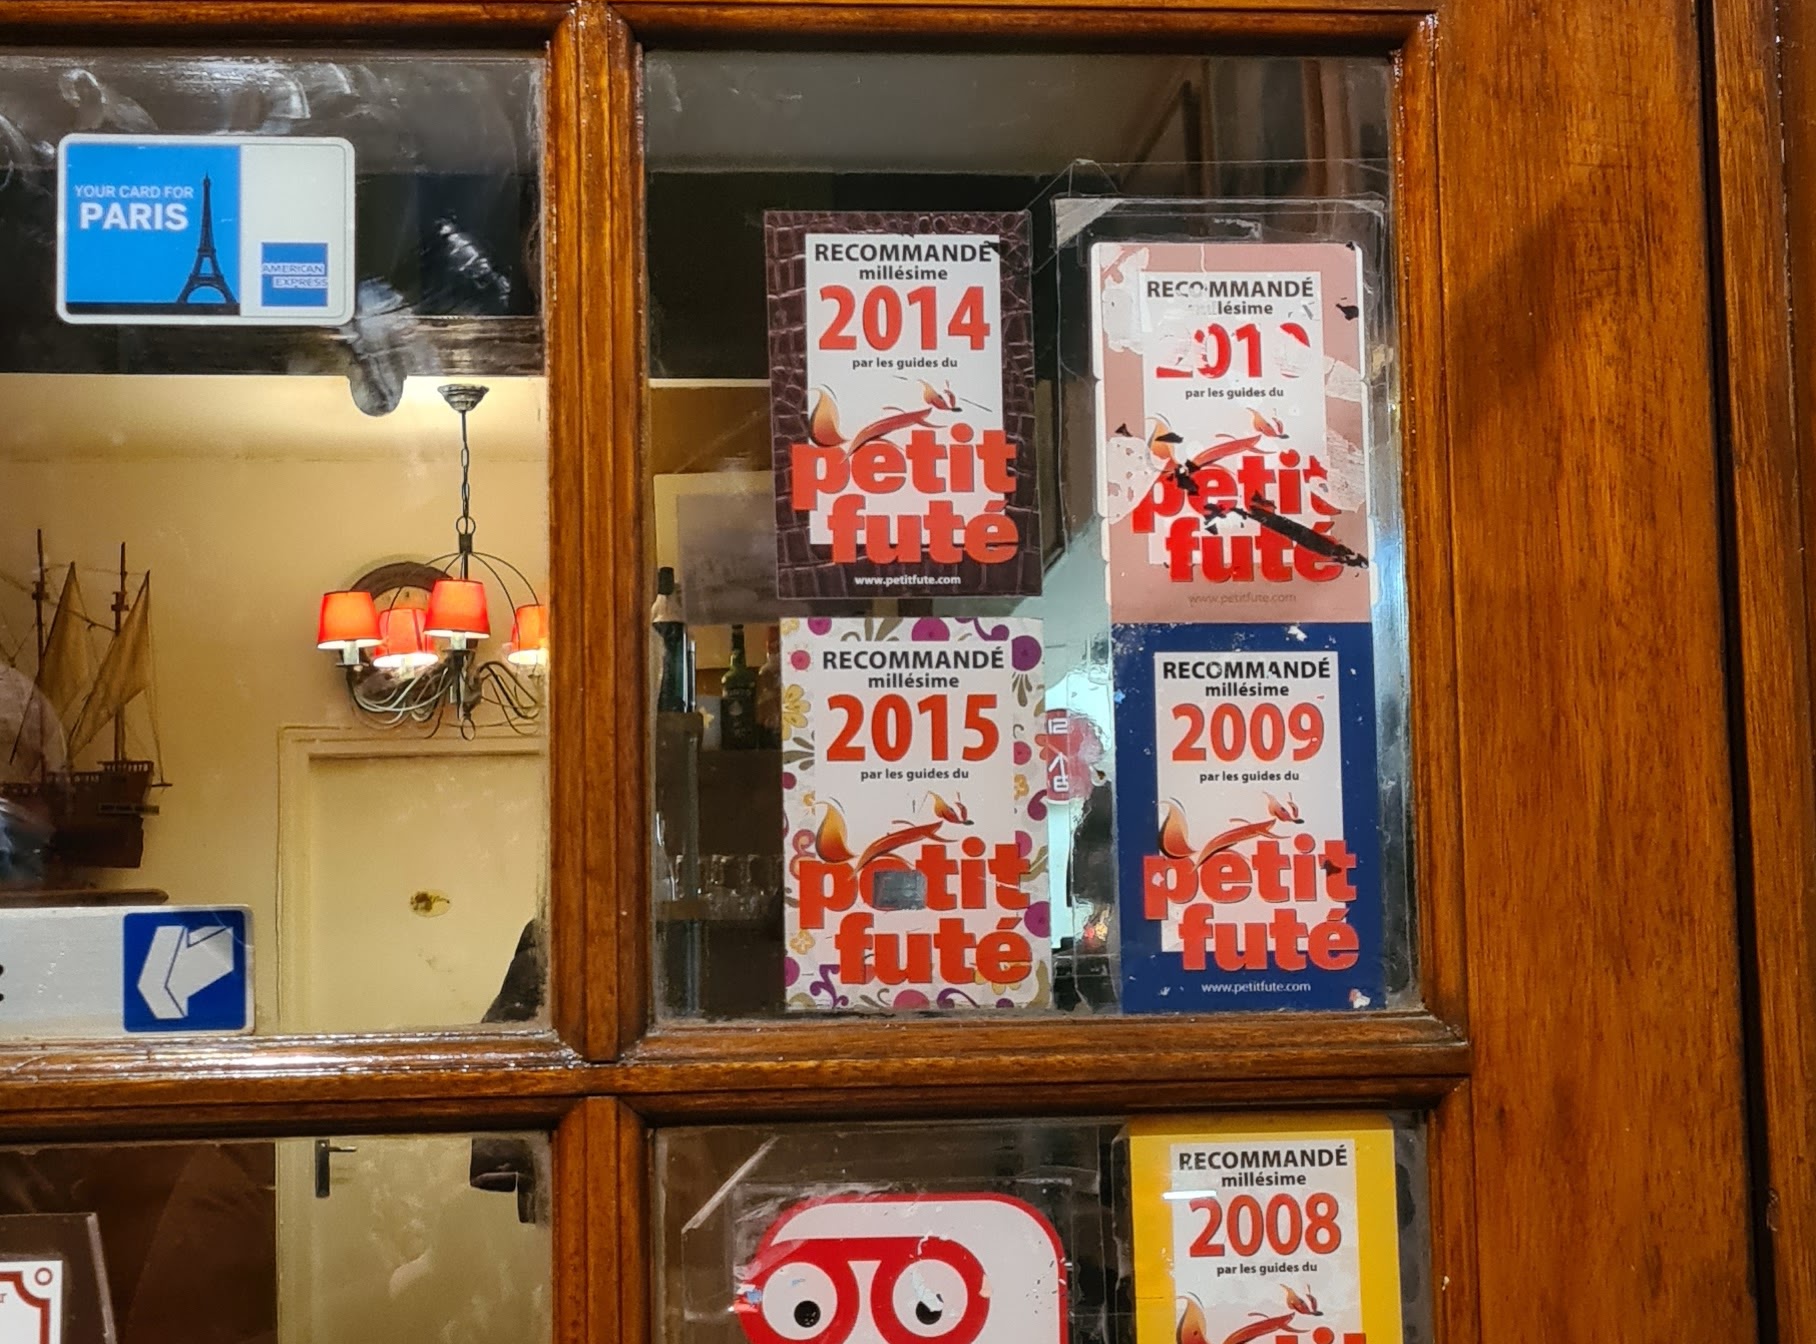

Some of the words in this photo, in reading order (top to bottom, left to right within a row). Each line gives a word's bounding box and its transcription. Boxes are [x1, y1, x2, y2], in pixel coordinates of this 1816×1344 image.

[75, 184, 115, 198] YOUR
[119, 185, 161, 199] CARD
[164, 186, 194, 199] FOR
[79, 202, 189, 230] PARIS
[262, 264, 323, 274] AMERICAN
[859, 265, 948, 280] millésime
[275, 277, 328, 287] EXPRESS
[819, 284, 990, 351] 2014
[852, 358, 873, 370] par
[876, 357, 894, 368] les
[896, 357, 939, 370] guides
[941, 357, 958, 368] du
[1185, 388, 1205, 400] par
[1207, 387, 1224, 398] les
[1226, 387, 1266, 400] guides
[1268, 387, 1284, 398] du
[791, 423, 1017, 511] petit
[828, 494, 1019, 564] futé
[1165, 517, 1344, 583] futé
[854, 574, 961, 586] www.petitfute.com
[1187, 592, 1297, 605] www.petitfute.com
[823, 646, 1004, 670] RECOMMANDÉ
[1163, 657, 1331, 680] RECOMMANDÉ
[868, 673, 960, 688] millésime
[1205, 682, 1289, 697] millésime
[826, 693, 1000, 762] 2015
[1171, 702, 1325, 762] 2009
[860, 769, 883, 782] par
[885, 768, 904, 780] les
[906, 768, 950, 782] guides
[953, 768, 969, 780] du
[1199, 772, 1220, 783] par
[1222, 771, 1239, 782] les
[1241, 771, 1282, 783] guides
[1284, 771, 1300, 782] du
[1143, 833, 1358, 921] petit
[1178, 903, 1360, 972] futé
[835, 912, 1033, 985] futé
[1201, 981, 1311, 994] www.petitfute.com
[1179, 1144, 1348, 1170] RECOMMANDÉ
[1221, 1172, 1306, 1188] millésime
[1189, 1192, 1342, 1257] 2008
[1217, 1265, 1237, 1277] par
[1240, 1264, 1256, 1274] les
[1259, 1262, 1299, 1275] guides
[1302, 1261, 1318, 1272] du
